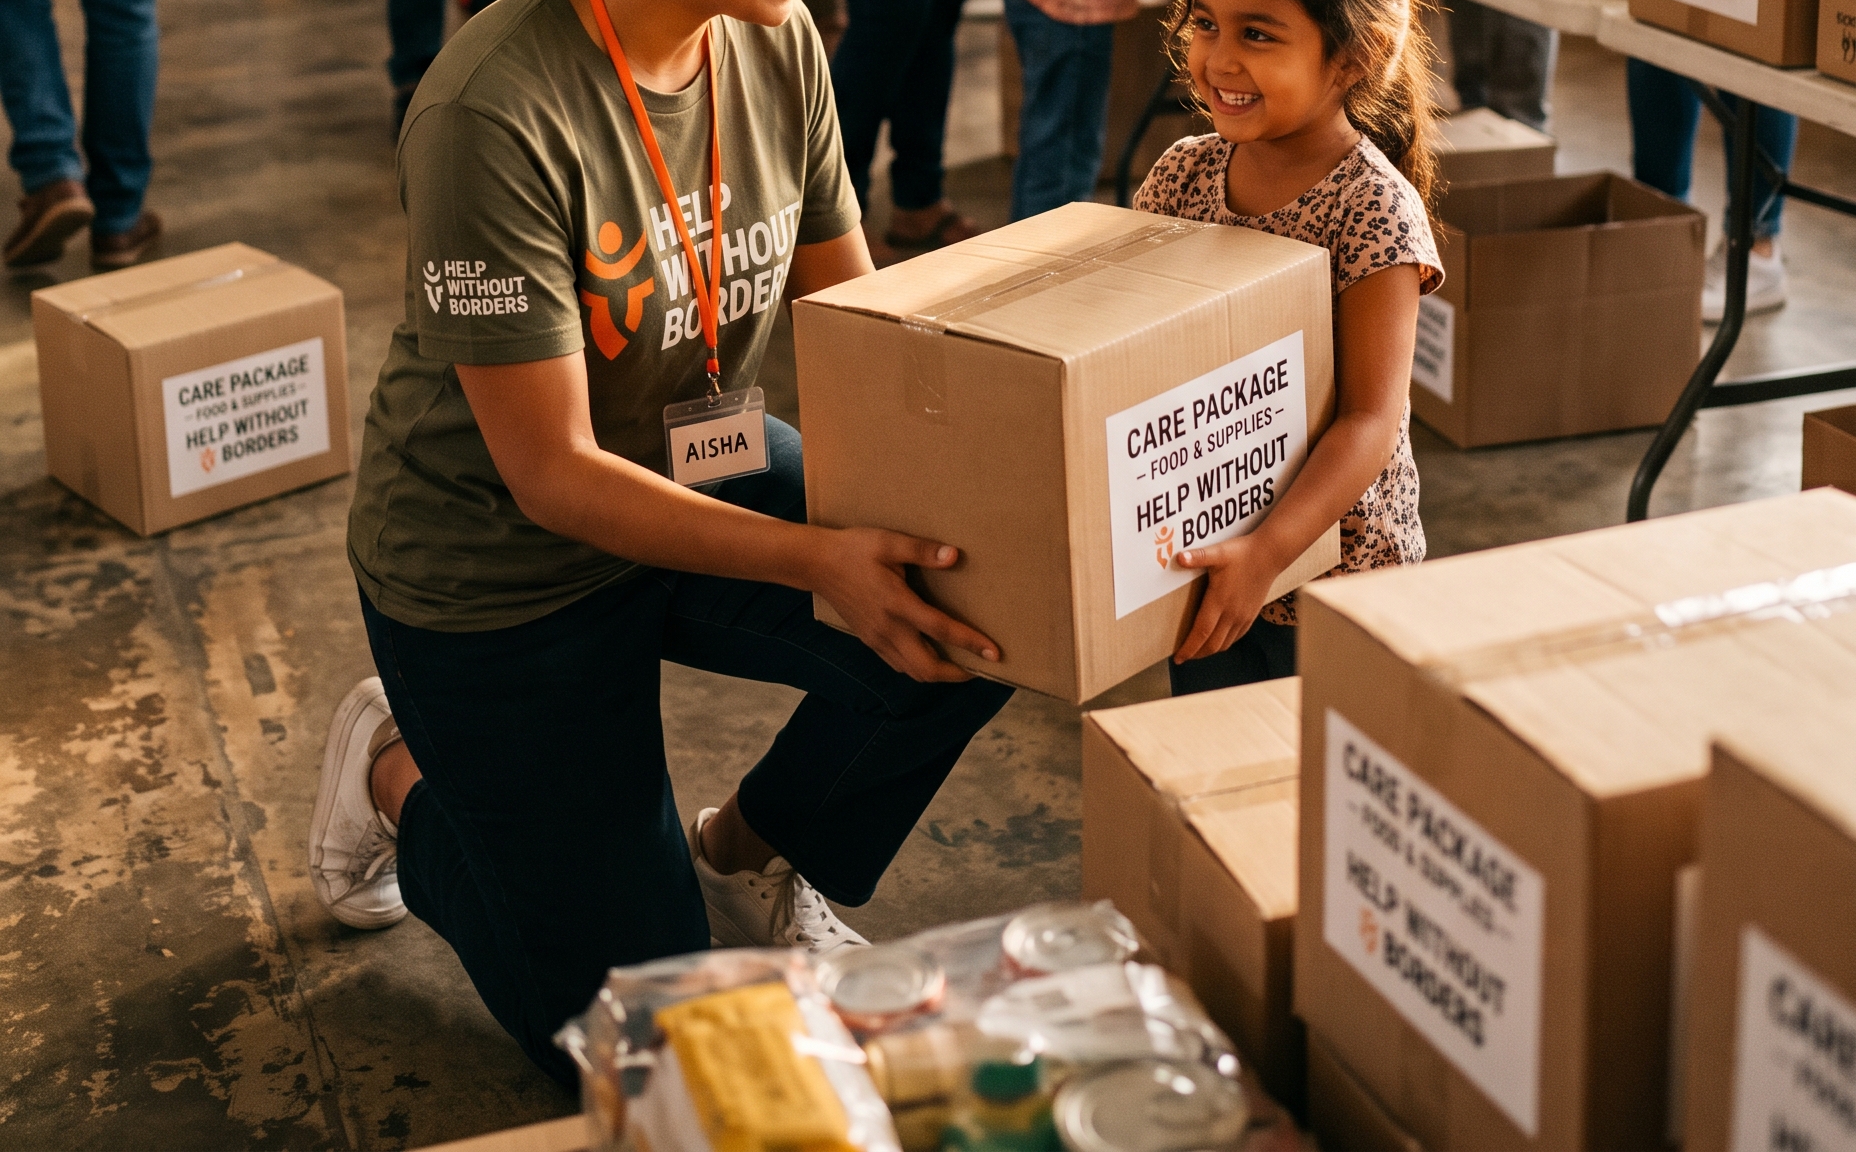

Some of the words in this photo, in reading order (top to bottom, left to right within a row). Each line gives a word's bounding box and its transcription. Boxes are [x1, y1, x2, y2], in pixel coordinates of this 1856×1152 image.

[650, 182, 732, 252] HELP
[661, 201, 800, 302] WTHOUT
[444, 260, 487, 278] HELP
[446, 276, 525, 296] WITHOUT
[449, 295, 529, 316] BORDERS
[179, 376, 225, 407] CARE
[230, 354, 309, 393] PACKAGE
[196, 401, 228, 421] FOOD
[231, 400, 239, 411] &
[242, 383, 297, 408] SUPPLIES
[1127, 407, 1186, 459] CARE
[1193, 359, 1289, 429] PACKAGE
[187, 423, 229, 449] HELP
[234, 400, 309, 436] WITHOUT
[222, 426, 299, 463] BORDERS
[686, 432, 749, 464] AISHA
[1151, 447, 1188, 480] FOOD
[1193, 440, 1203, 459] &
[1207, 407, 1272, 453] SUPPLIES
[1137, 483, 1190, 532] HELP
[1197, 433, 1288, 502] WITHOUT
[1182, 478, 1275, 548] BORDERS
[1344, 742, 1402, 817] CARE
[1407, 792, 1518, 915] PACKAGE
[1346, 851, 1397, 912] HELP
[1406, 900, 1507, 1015] WITHOUT
[1384, 931, 1485, 1048] BORDERS
